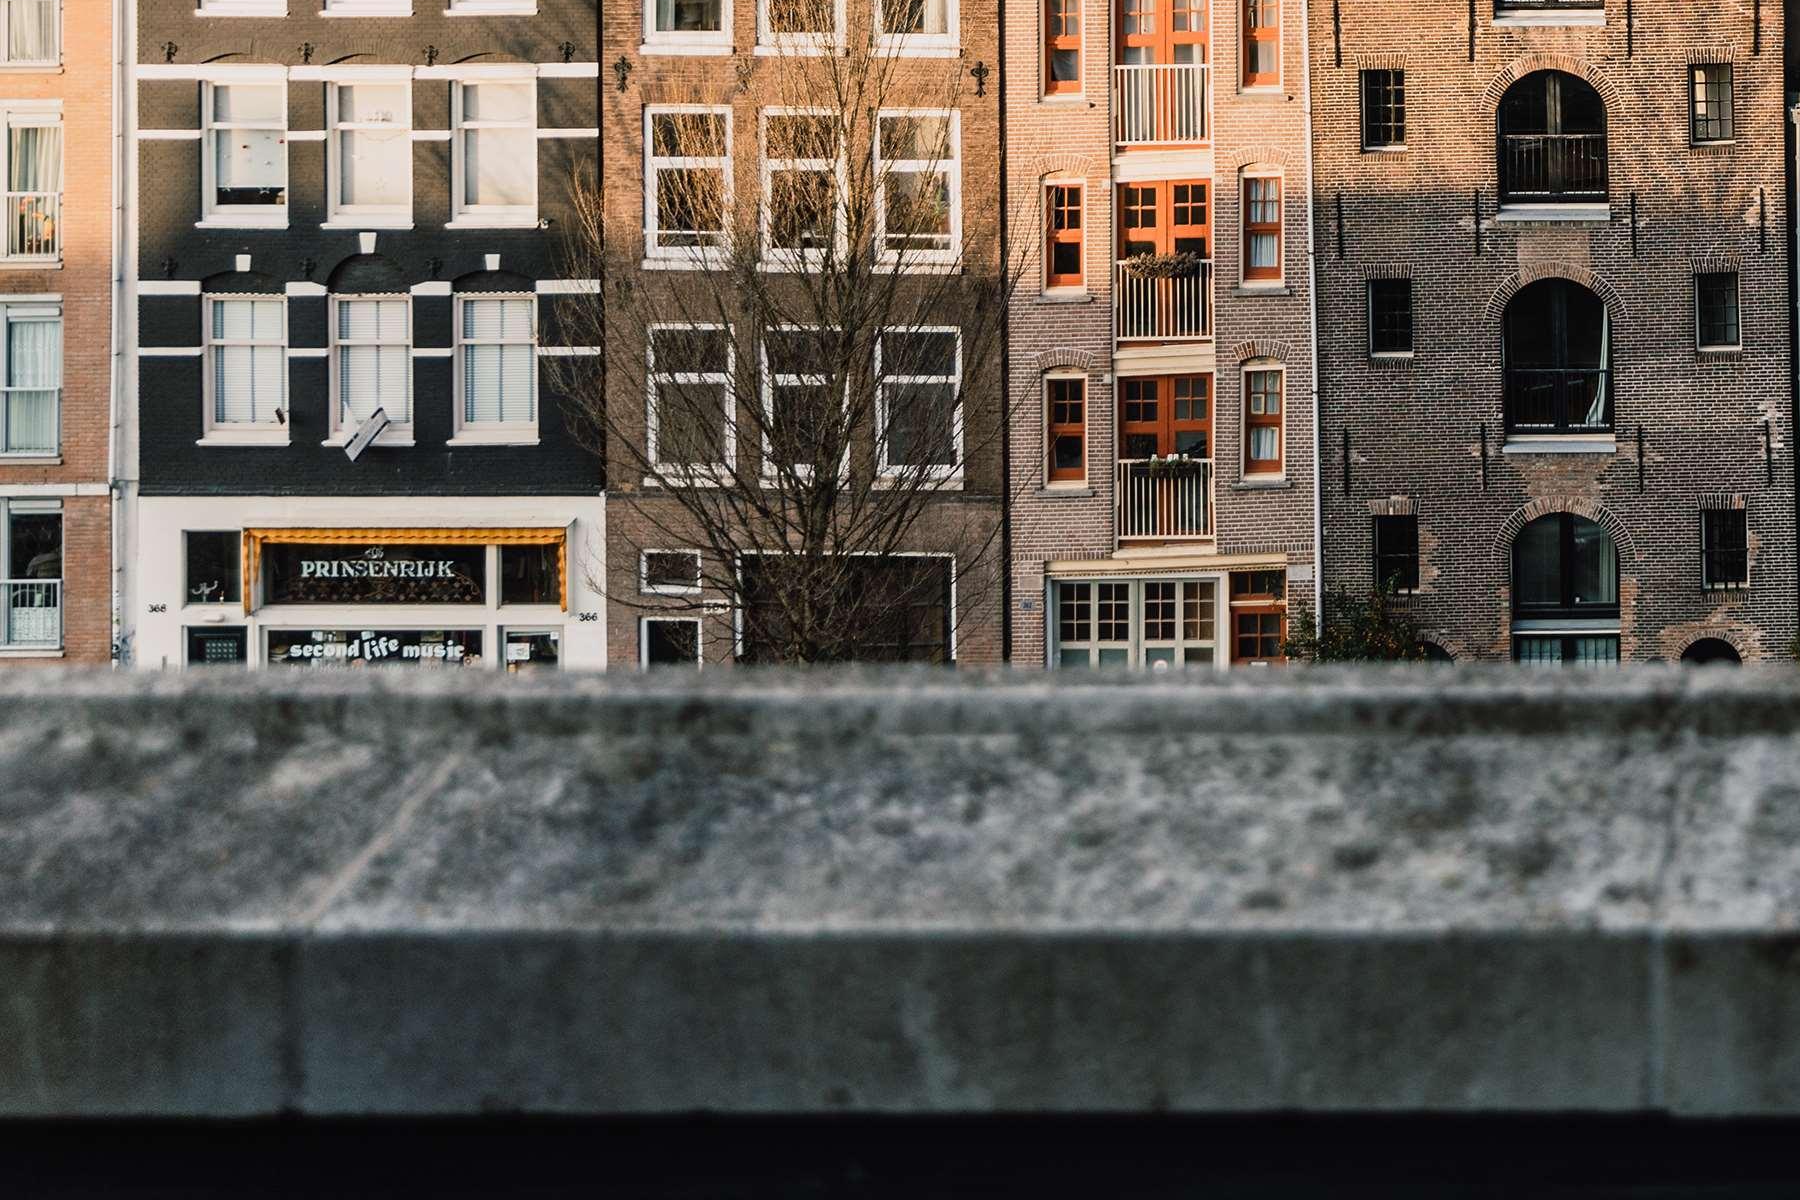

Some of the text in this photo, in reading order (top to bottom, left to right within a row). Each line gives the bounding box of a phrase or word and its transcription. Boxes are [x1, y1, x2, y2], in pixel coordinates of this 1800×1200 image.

[301, 560, 455, 578] PRINSENRIJK
[579, 612, 598, 621] 366
[289, 636, 465, 660] second life music
